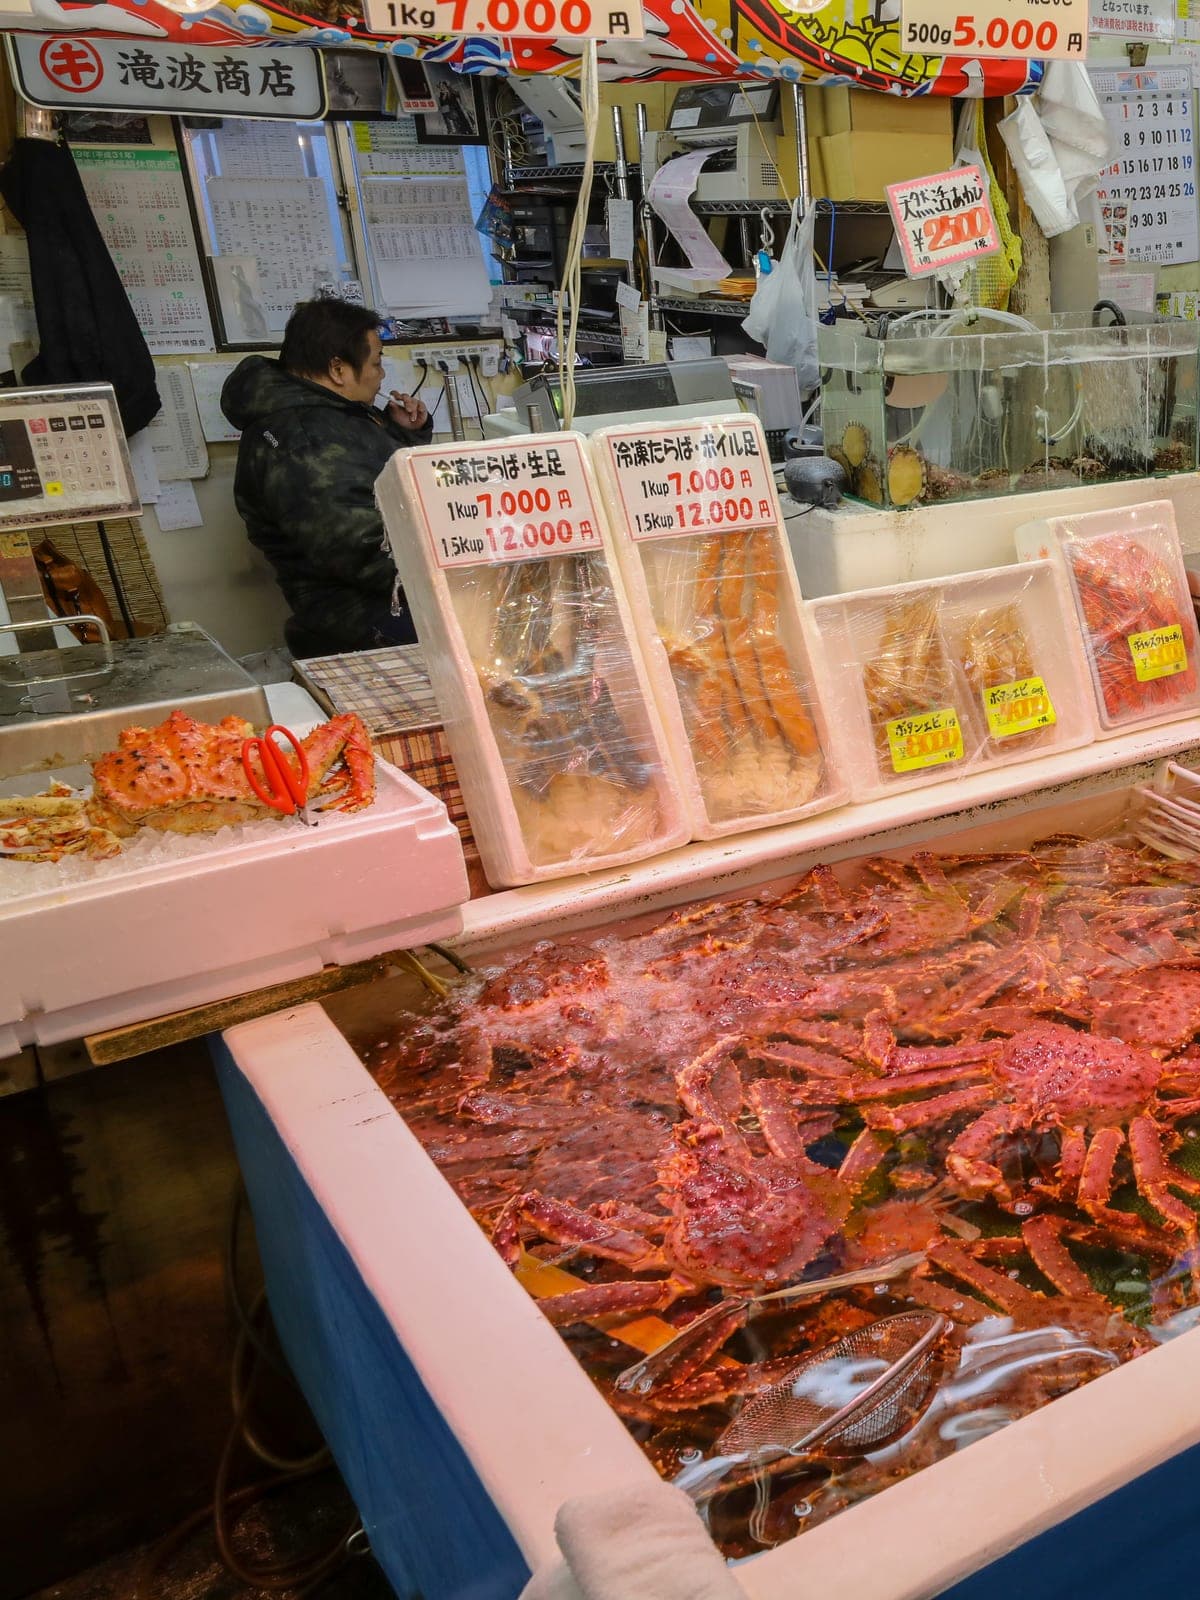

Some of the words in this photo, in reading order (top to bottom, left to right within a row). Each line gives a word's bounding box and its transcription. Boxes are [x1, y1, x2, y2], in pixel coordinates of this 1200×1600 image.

[608, 11, 630, 34] 円
[908, 23, 952, 45] 500g
[953, 16, 1058, 51] 5,000
[1067, 32, 1082, 51] 円
[117, 48, 296, 98] 滝波商店
[1123, 104, 1128, 118] 1
[1137, 104, 1144, 117] 2
[1152, 103, 1158, 116] 3
[1167, 102, 1173, 116] 4
[1182, 101, 1188, 115] 5
[1124, 132, 1130, 146] 8
[1139, 131, 1145, 145] 9
[1151, 130, 1162, 144] 10
[1166, 129, 1177, 143] 11
[1180, 128, 1191, 142] 12
[1123, 160, 1135, 174] 15
[1138, 158, 1149, 173] 16
[1152, 157, 1163, 172] 17
[1167, 156, 1179, 170] 18
[1182, 155, 1192, 169] 19
[1125, 187, 1137, 200] 22
[1140, 186, 1151, 200] 23
[1154, 185, 1166, 199] 24
[1169, 184, 1181, 197] 25
[1183, 182, 1194, 196] 26
[1142, 213, 1153, 227] 30
[1157, 211, 1167, 225] 31
[613, 430, 759, 468] 冷凍たらば・ボイル足
[432, 448, 566, 488] 冷凍たらば・生足
[740, 469, 752, 488] 円
[557, 489, 572, 509] 円
[675, 497, 753, 528] 12,000
[759, 499, 771, 518] 円
[579, 520, 594, 541] 円
[896, 714, 941, 736] ボタンエビ
